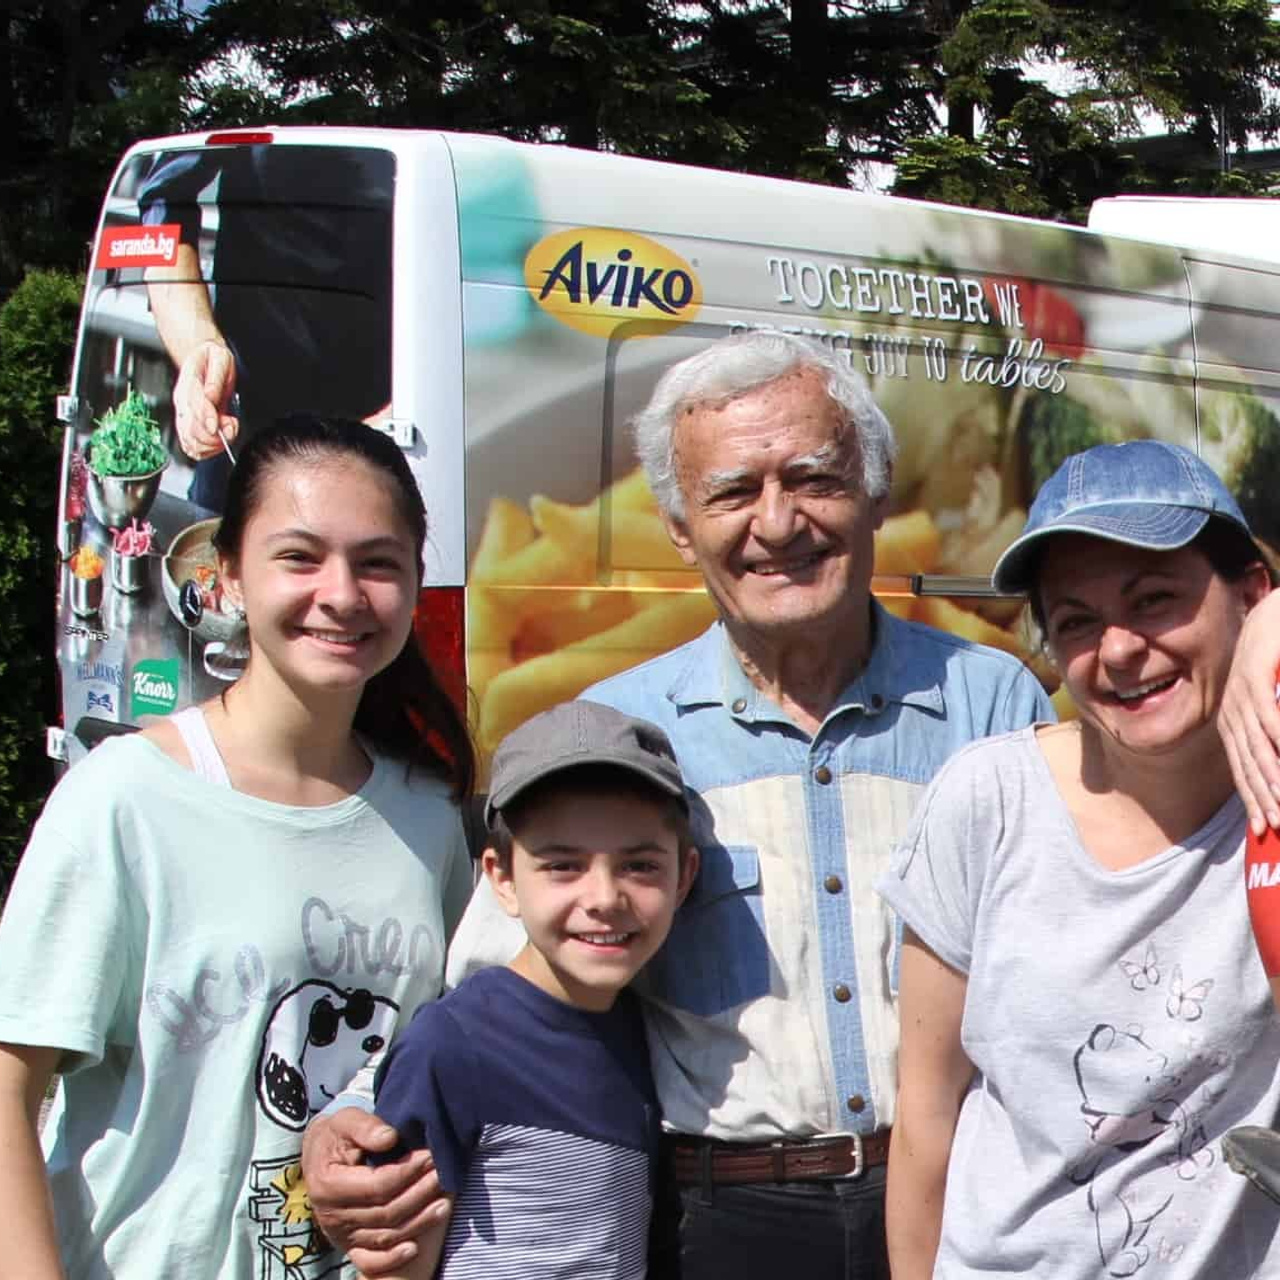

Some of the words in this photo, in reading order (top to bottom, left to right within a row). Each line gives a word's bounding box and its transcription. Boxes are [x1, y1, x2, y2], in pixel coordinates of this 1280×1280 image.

[109, 231, 177, 262] saranda.bg
[538, 240, 695, 316] Aviko
[767, 256, 990, 325] TOGETHER
[992, 281, 1025, 329] WE
[922, 336, 947, 382] TO
[959, 338, 1074, 394] tables
[133, 672, 176, 700] Knorr
